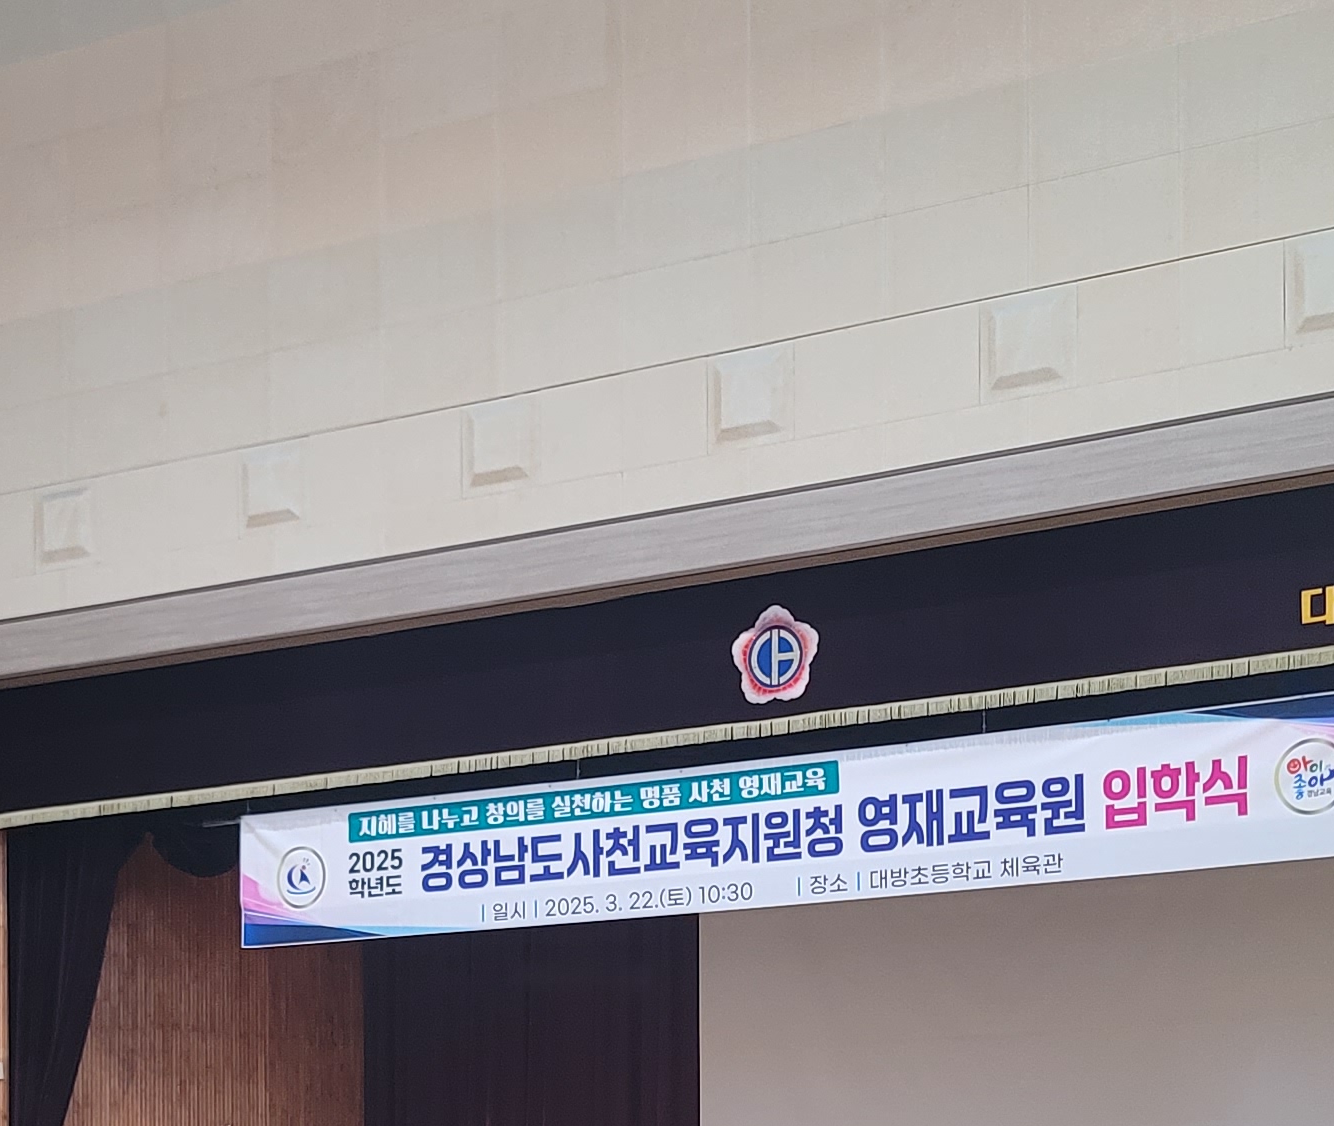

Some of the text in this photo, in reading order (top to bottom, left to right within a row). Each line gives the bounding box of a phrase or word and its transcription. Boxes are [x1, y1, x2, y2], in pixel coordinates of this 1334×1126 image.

[358, 767, 827, 837] 지혜를 나누고 창의를 실천하는 명품 사천 영재교육
[421, 754, 1249, 893] 경상남도사천교육지원청 영재교육원 입학식
[348, 848, 403, 874] 2025
[809, 852, 1064, 895] 장소 대방초등학교 체육관
[348, 874, 403, 898] 학년도
[492, 900, 526, 921] 일시
[545, 895, 599, 917] 2025.
[605, 894, 623, 912] 3.
[698, 881, 753, 905] 10:30
